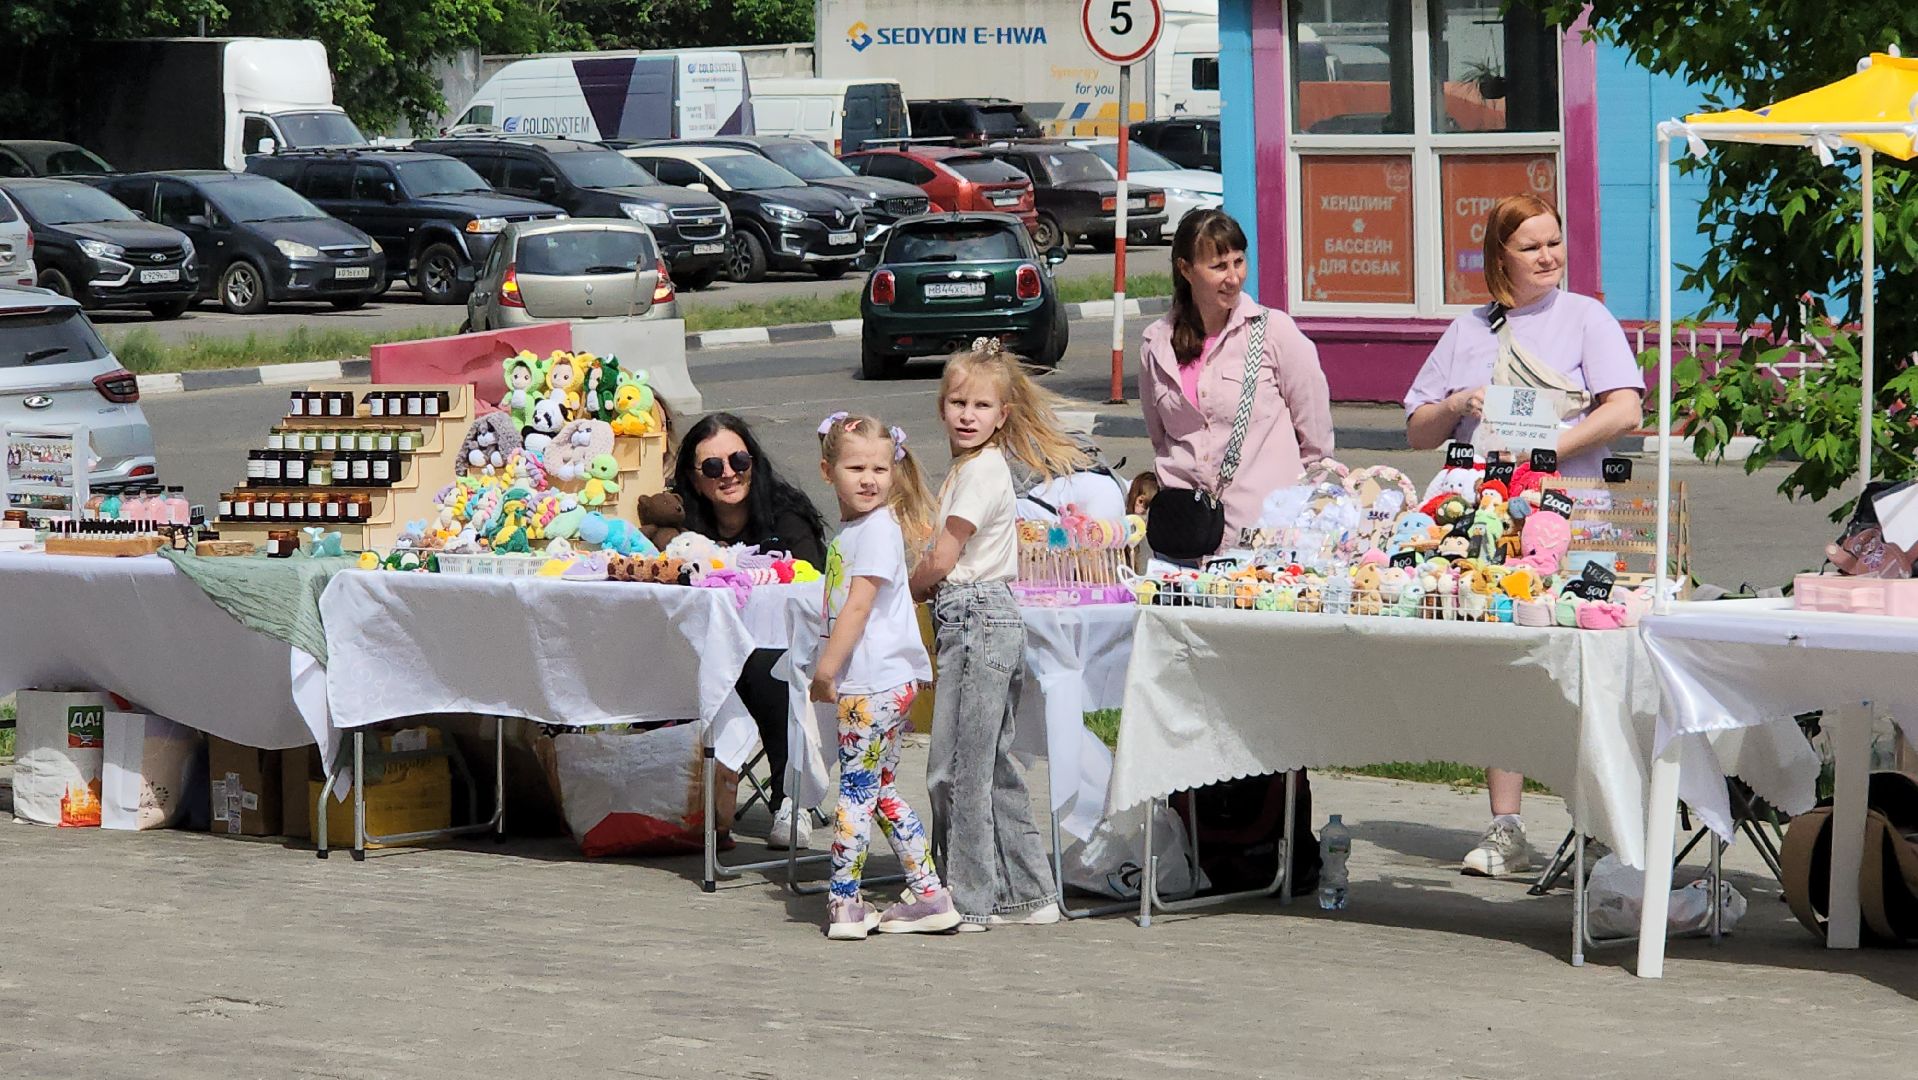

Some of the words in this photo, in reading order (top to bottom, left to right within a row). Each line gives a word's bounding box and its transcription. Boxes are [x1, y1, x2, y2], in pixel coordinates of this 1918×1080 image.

[1110, 1, 1133, 35] 5
[877, 27, 967, 45] SEOYON
[974, 27, 1047, 45] E-HWA
[1075, 82, 1092, 95] for
[1094, 84, 1115, 98] you
[522, 116, 590, 135] COLDSYSTEM
[1321, 195, 1396, 212] ХЕНДЛИНГ
[1324, 236, 1393, 253] БАССЕЙН
[1319, 258, 1348, 275] ДЛЯ
[1351, 259, 1400, 276] СОБАК
[1544, 494, 1572, 515] 2000
[1586, 585, 1608, 599] 500
[71, 711, 101, 728] ДА!
